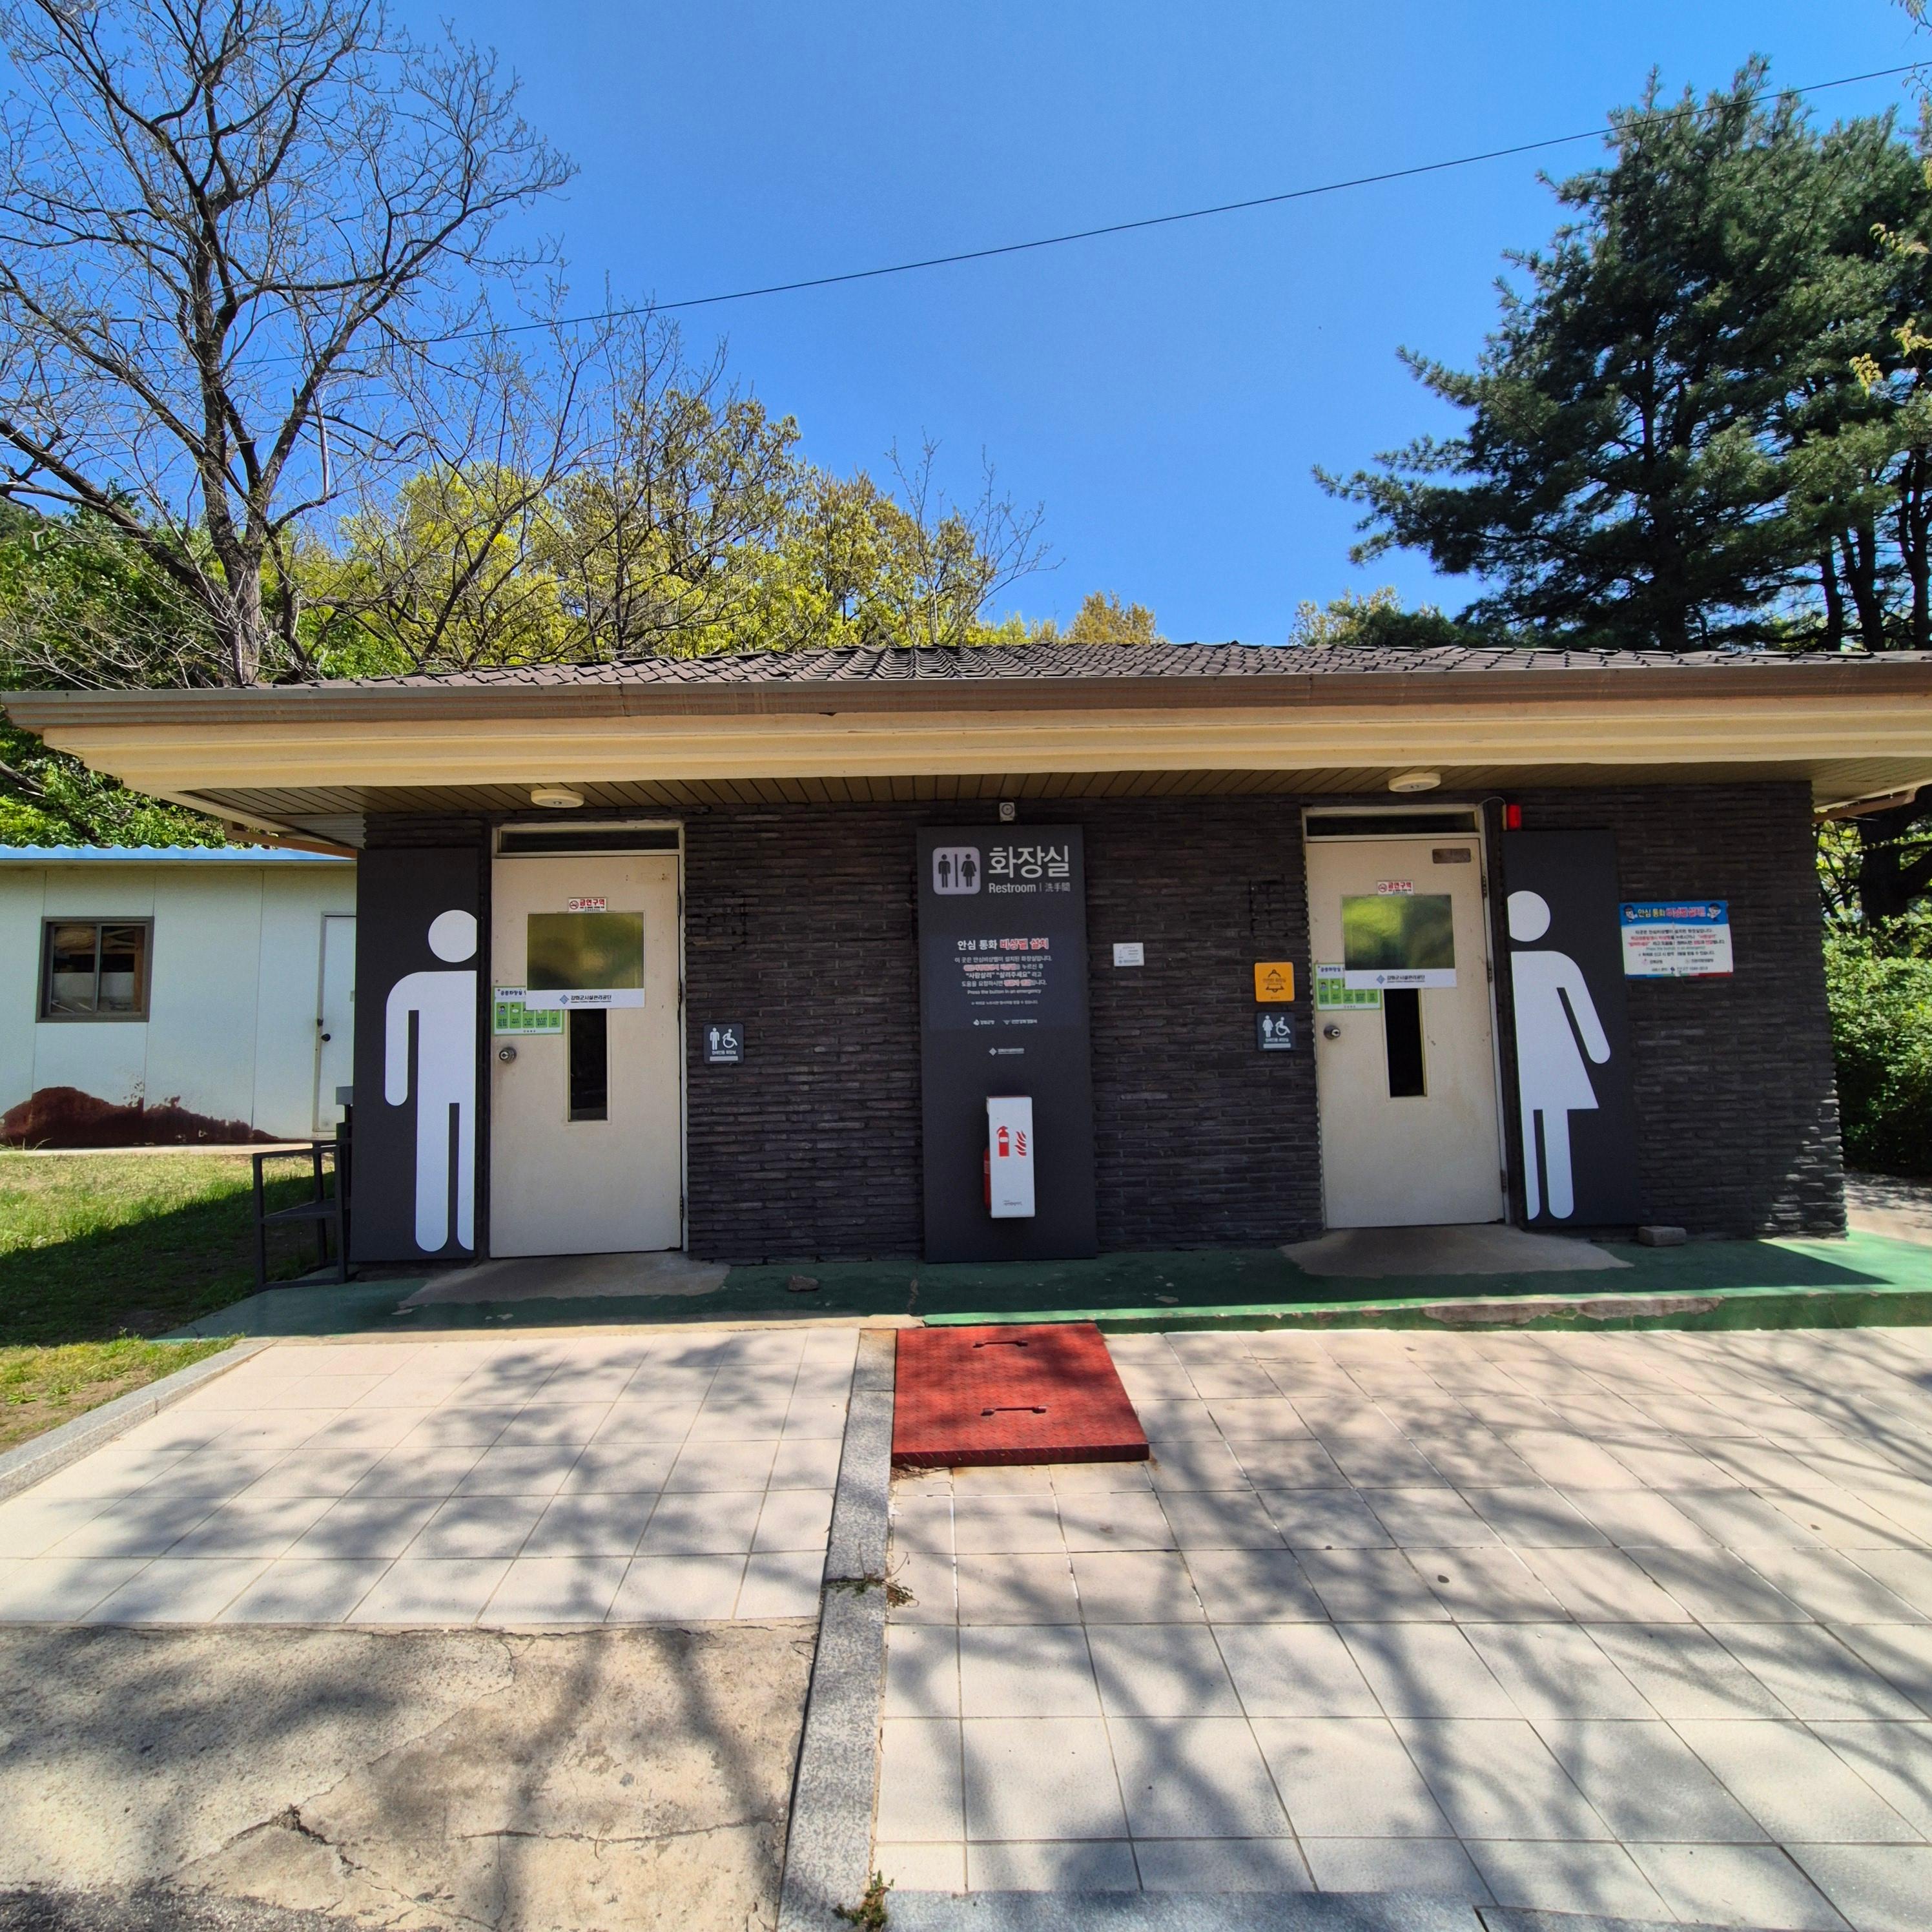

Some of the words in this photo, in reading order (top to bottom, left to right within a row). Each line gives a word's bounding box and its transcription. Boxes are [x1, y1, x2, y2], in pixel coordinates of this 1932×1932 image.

[989, 845, 1069, 878] 화장실
[989, 883, 1036, 894] Restroom
[1045, 882, 1071, 892] 洗手間
[1638, 909, 1651, 918] 안심
[957, 940, 976, 951] 안심
[979, 940, 997, 950] 통화
[1000, 938, 1028, 950] 비상벨
[1030, 938, 1049, 950] 설치
